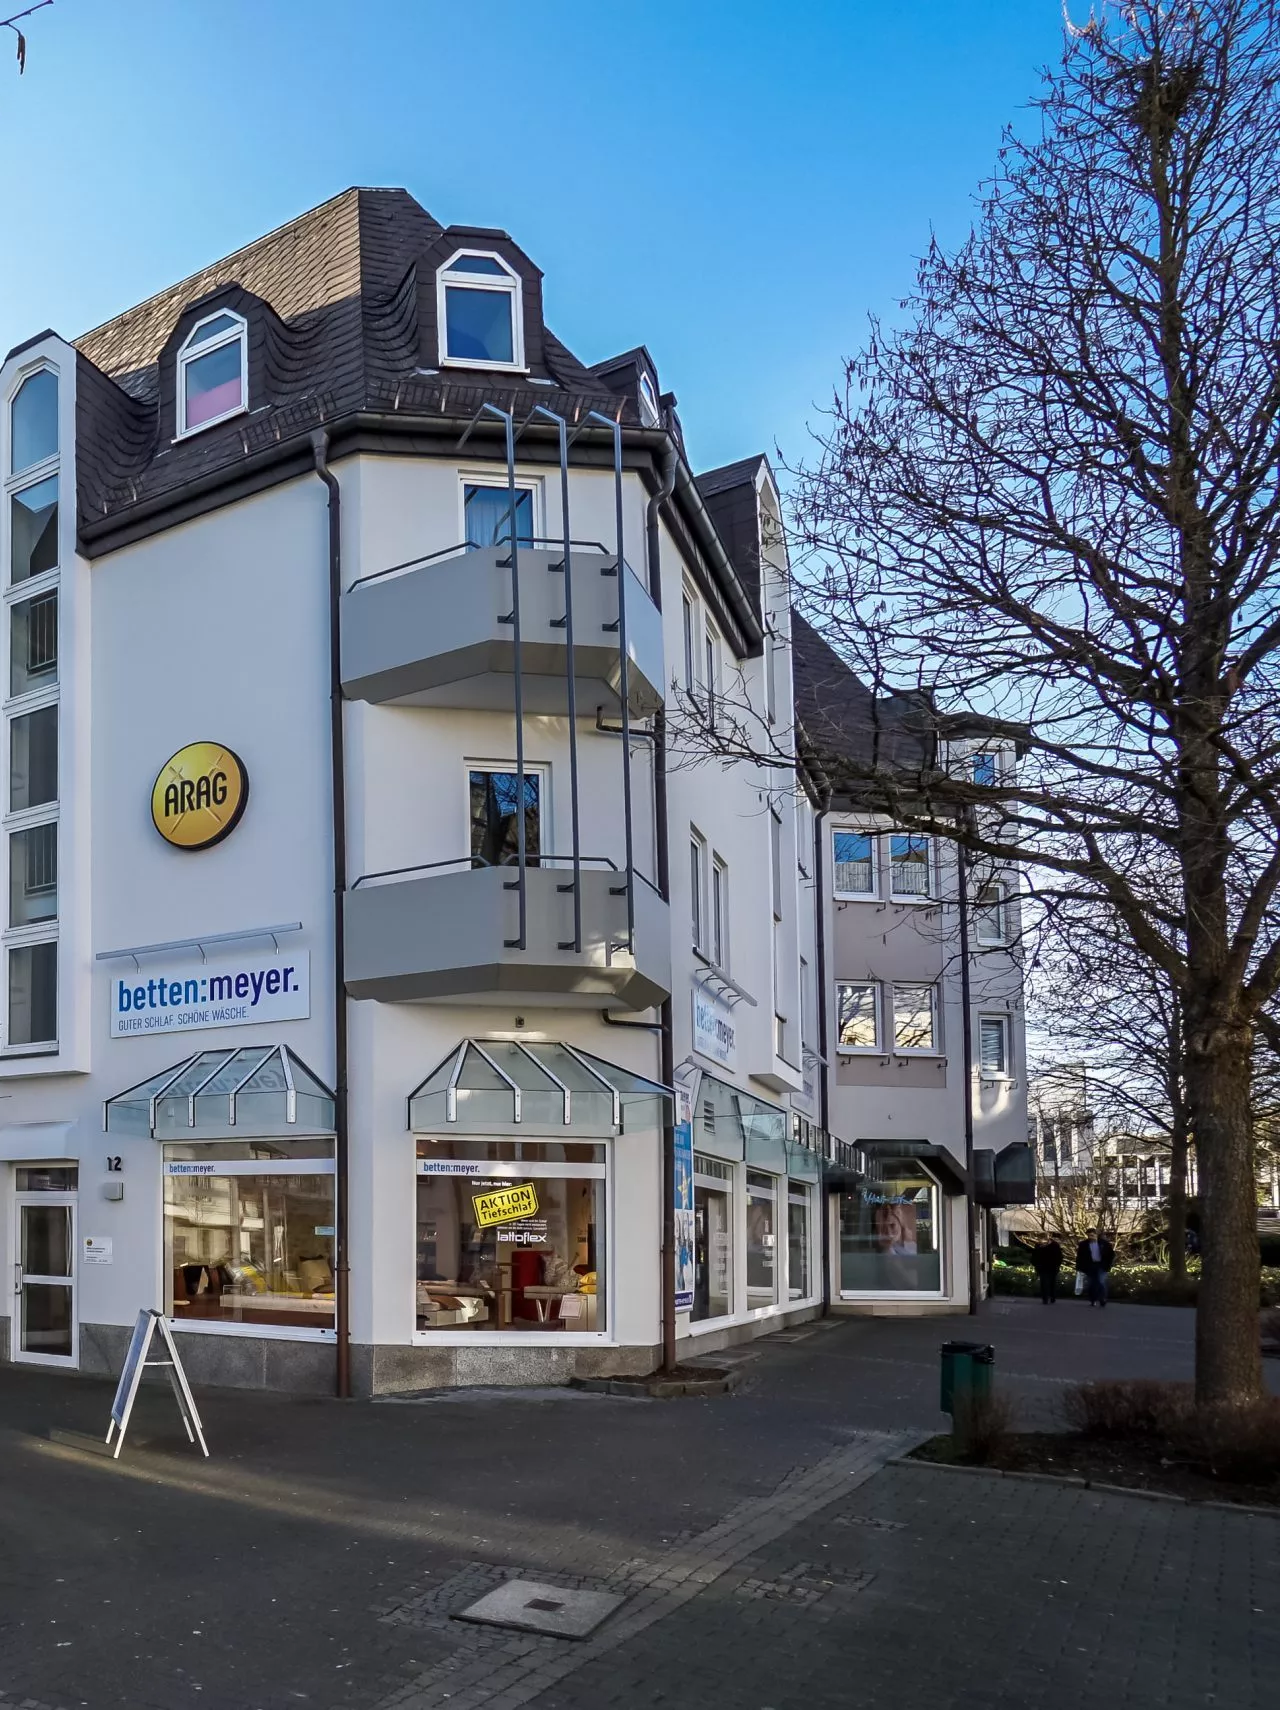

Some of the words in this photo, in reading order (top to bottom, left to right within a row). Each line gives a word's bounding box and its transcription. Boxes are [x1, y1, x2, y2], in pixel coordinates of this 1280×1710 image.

[164, 771, 228, 817] ARAG
[118, 966, 299, 1012] betten:meyer.
[118, 1017, 142, 1031] GUTER
[144, 1014, 175, 1028] SCHLAF.
[177, 1009, 209, 1025] SCHÖNE
[211, 1006, 250, 1022] WÄSCHE.
[107, 1156, 122, 1171] 12
[169, 1163, 216, 1174] betten:meyer.
[423, 1162, 480, 1175] betten:meyer.
[480, 1189, 531, 1211] AKTION
[481, 1201, 533, 1220] Tiefschlaf
[497, 1231, 548, 1245] lattoflex
